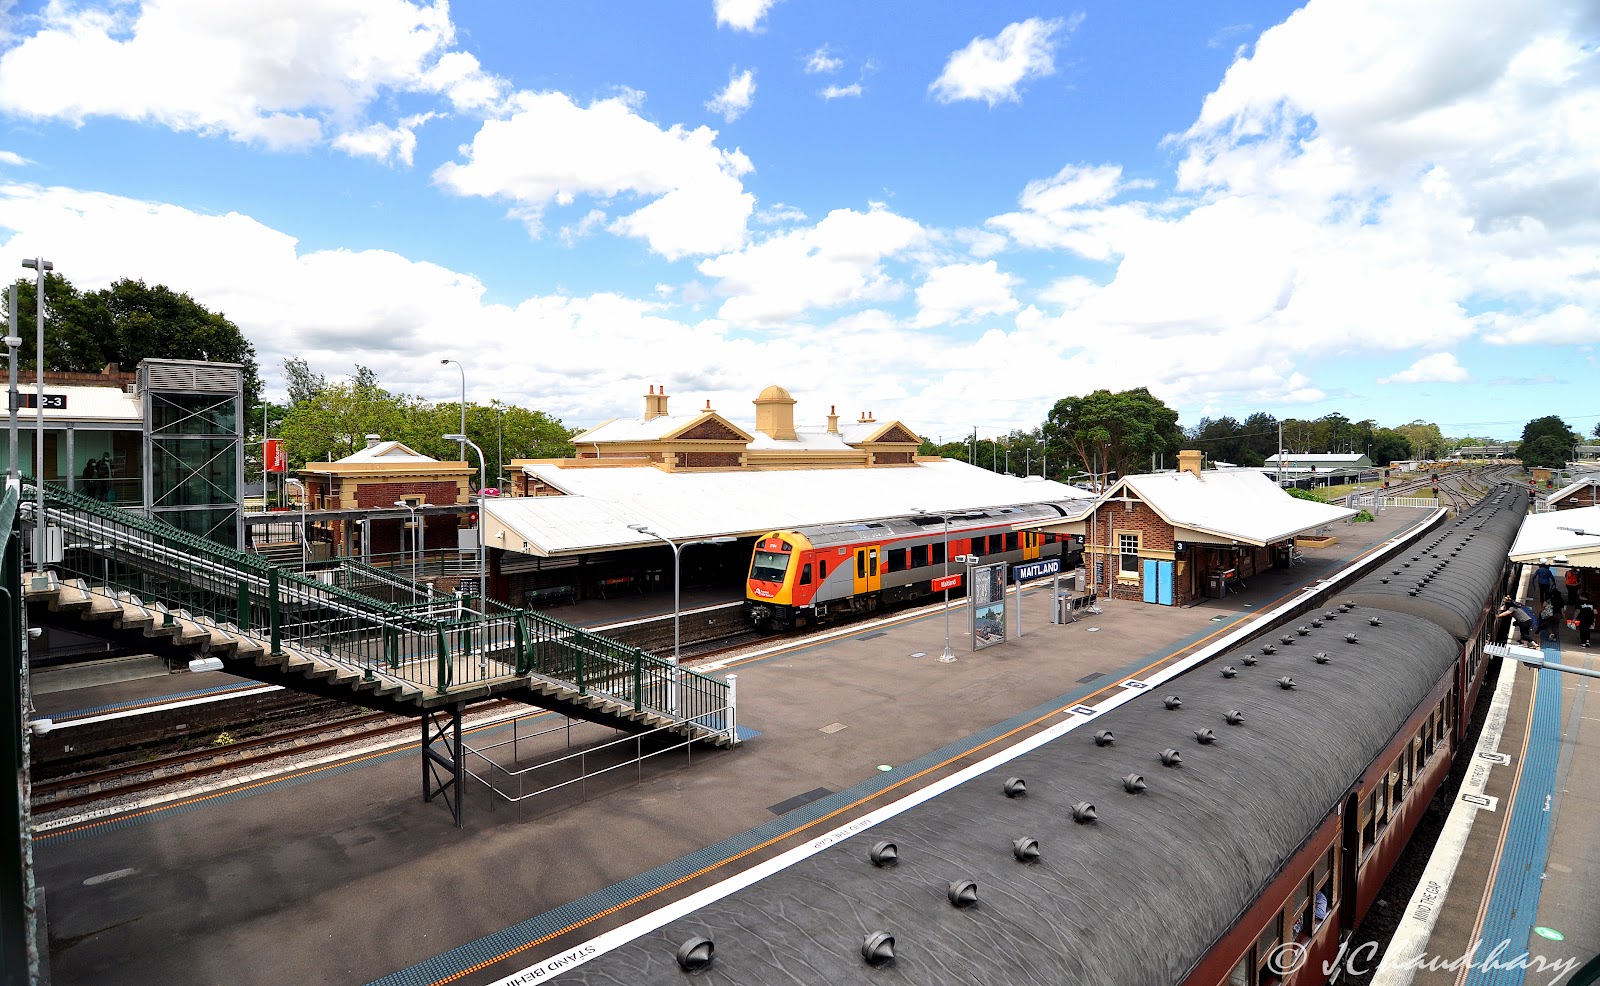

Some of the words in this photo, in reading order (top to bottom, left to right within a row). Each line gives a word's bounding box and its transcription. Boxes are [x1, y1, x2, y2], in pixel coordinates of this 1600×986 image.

[1020, 562, 1059, 579] MAITLAND
[940, 579, 957, 588] Maitland
[1426, 880, 1442, 895] GAP
[1420, 892, 1437, 906] THE
[1412, 904, 1431, 923] MIND
[547, 945, 597, 972] STAND
